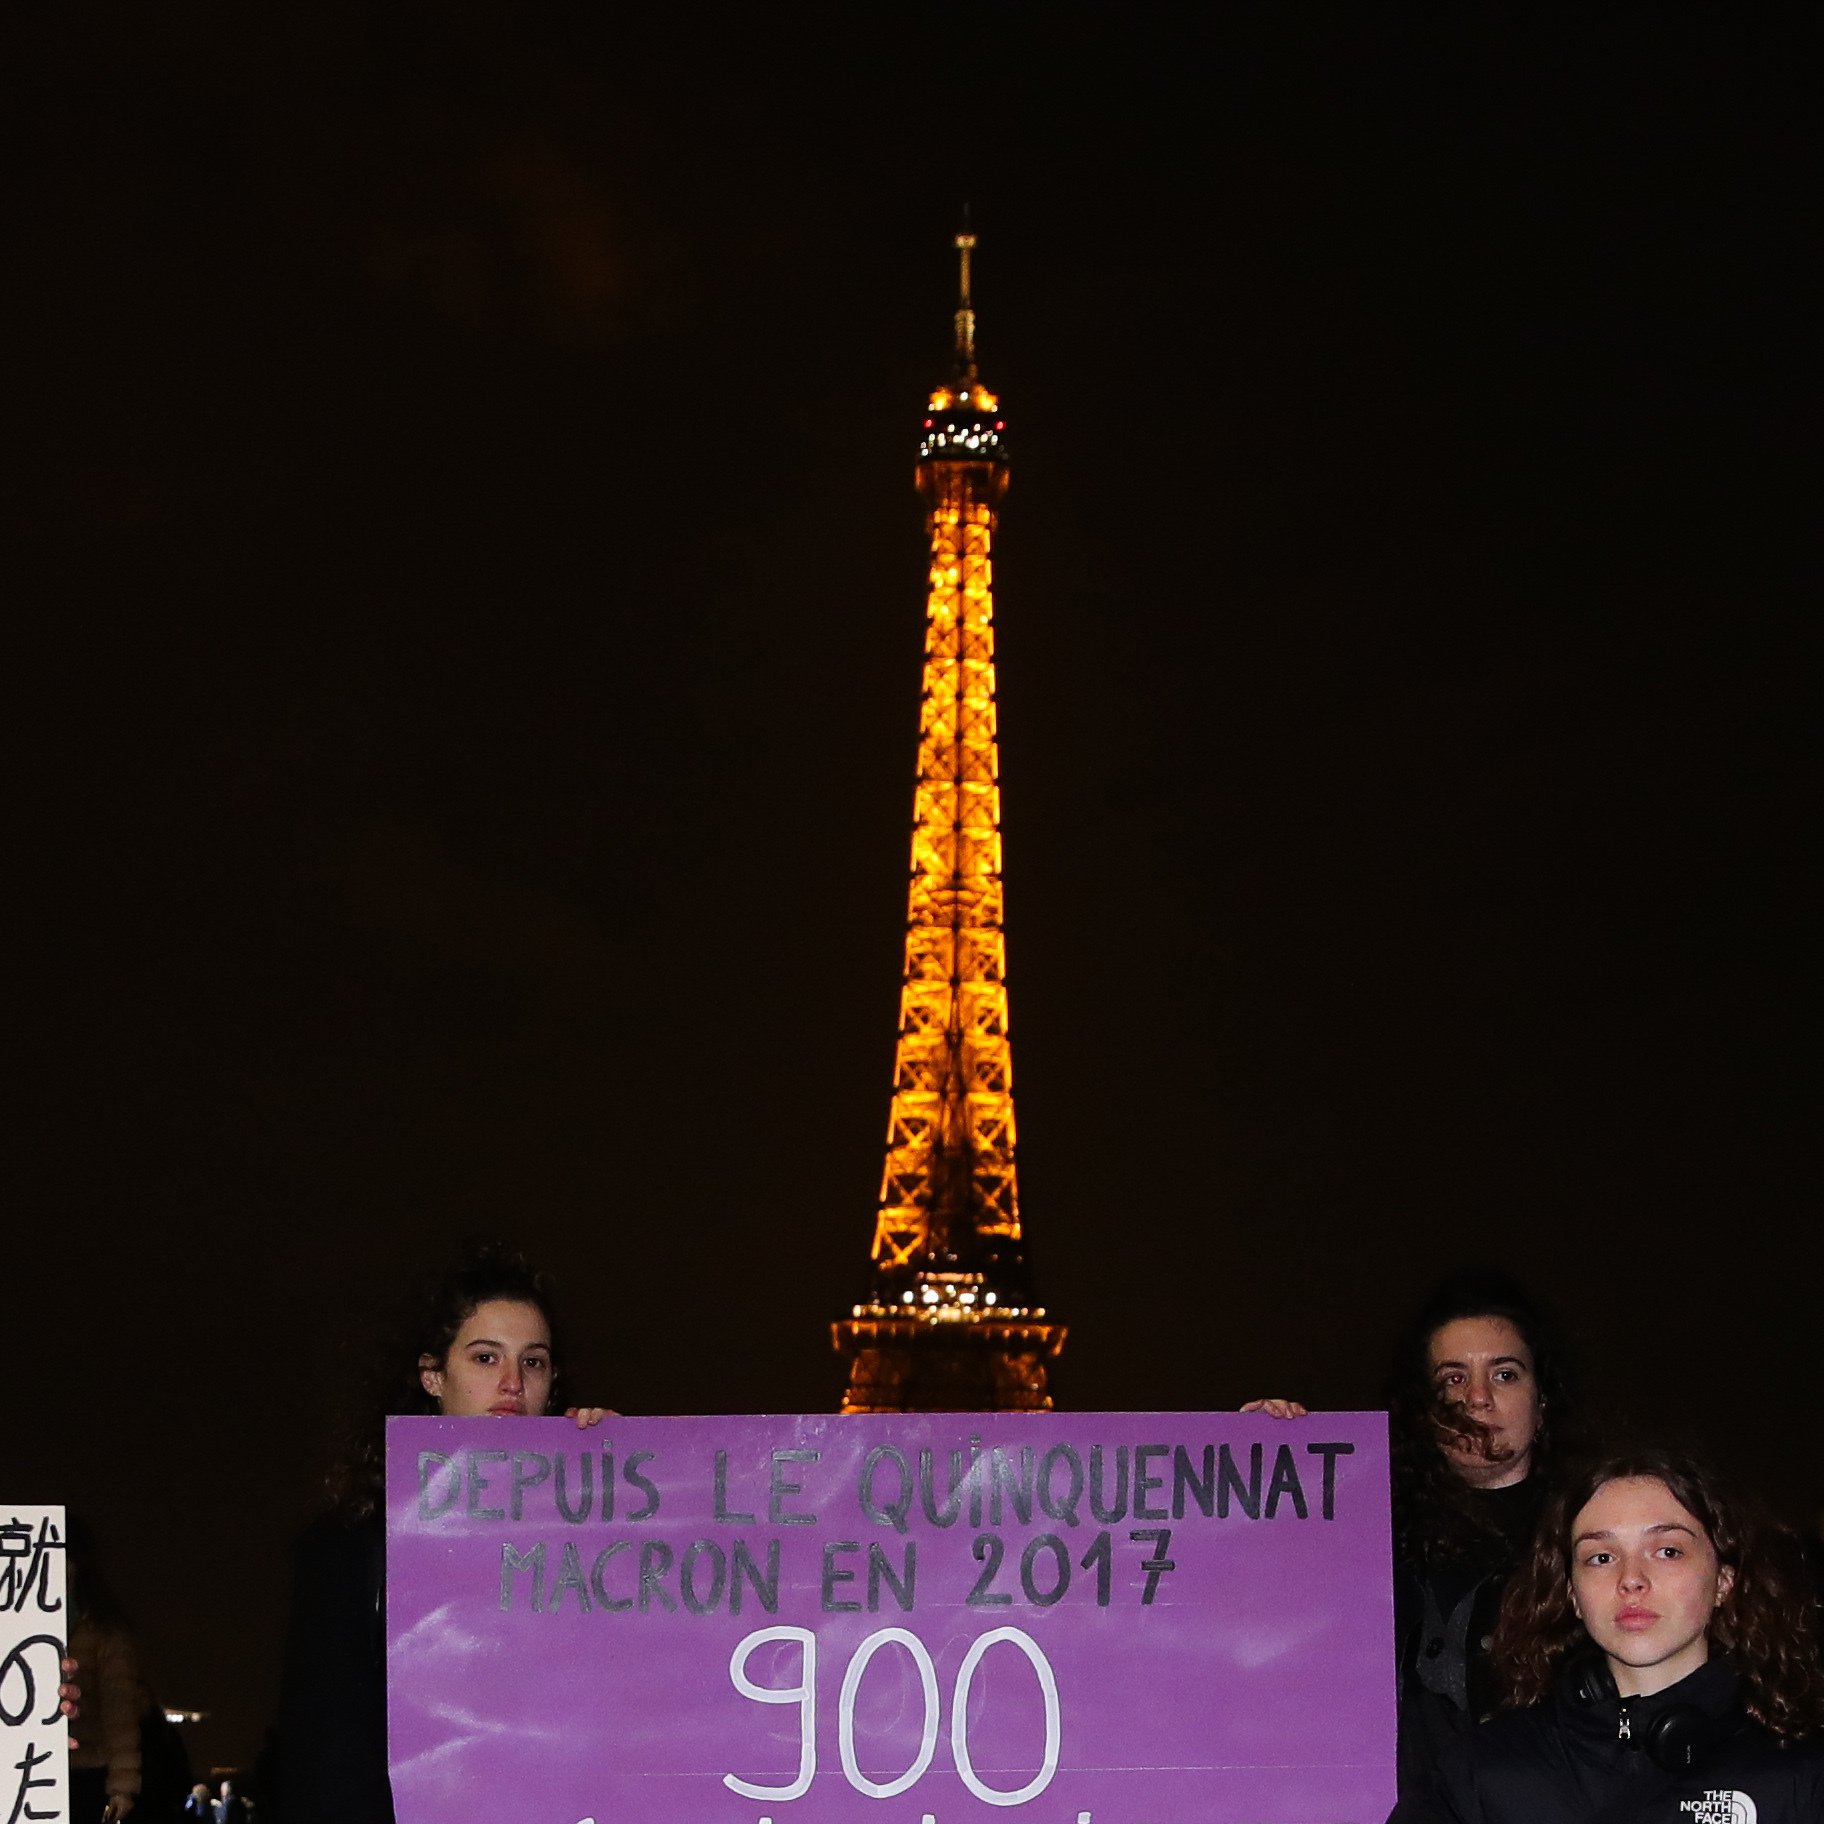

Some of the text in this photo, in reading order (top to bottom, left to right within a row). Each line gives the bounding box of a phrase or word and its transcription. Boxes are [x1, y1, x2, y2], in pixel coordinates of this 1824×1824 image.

[417, 1432, 1355, 1534] DEPUIS LE QUINQUENNAT
[498, 1527, 1176, 1616] MACRON EN 2017
[723, 1626, 1060, 1806] 900
[1680, 1800, 1732, 1812] NORTH
[1695, 1812, 1731, 1824] FACE
[1703, 1790, 1732, 1801] THE
